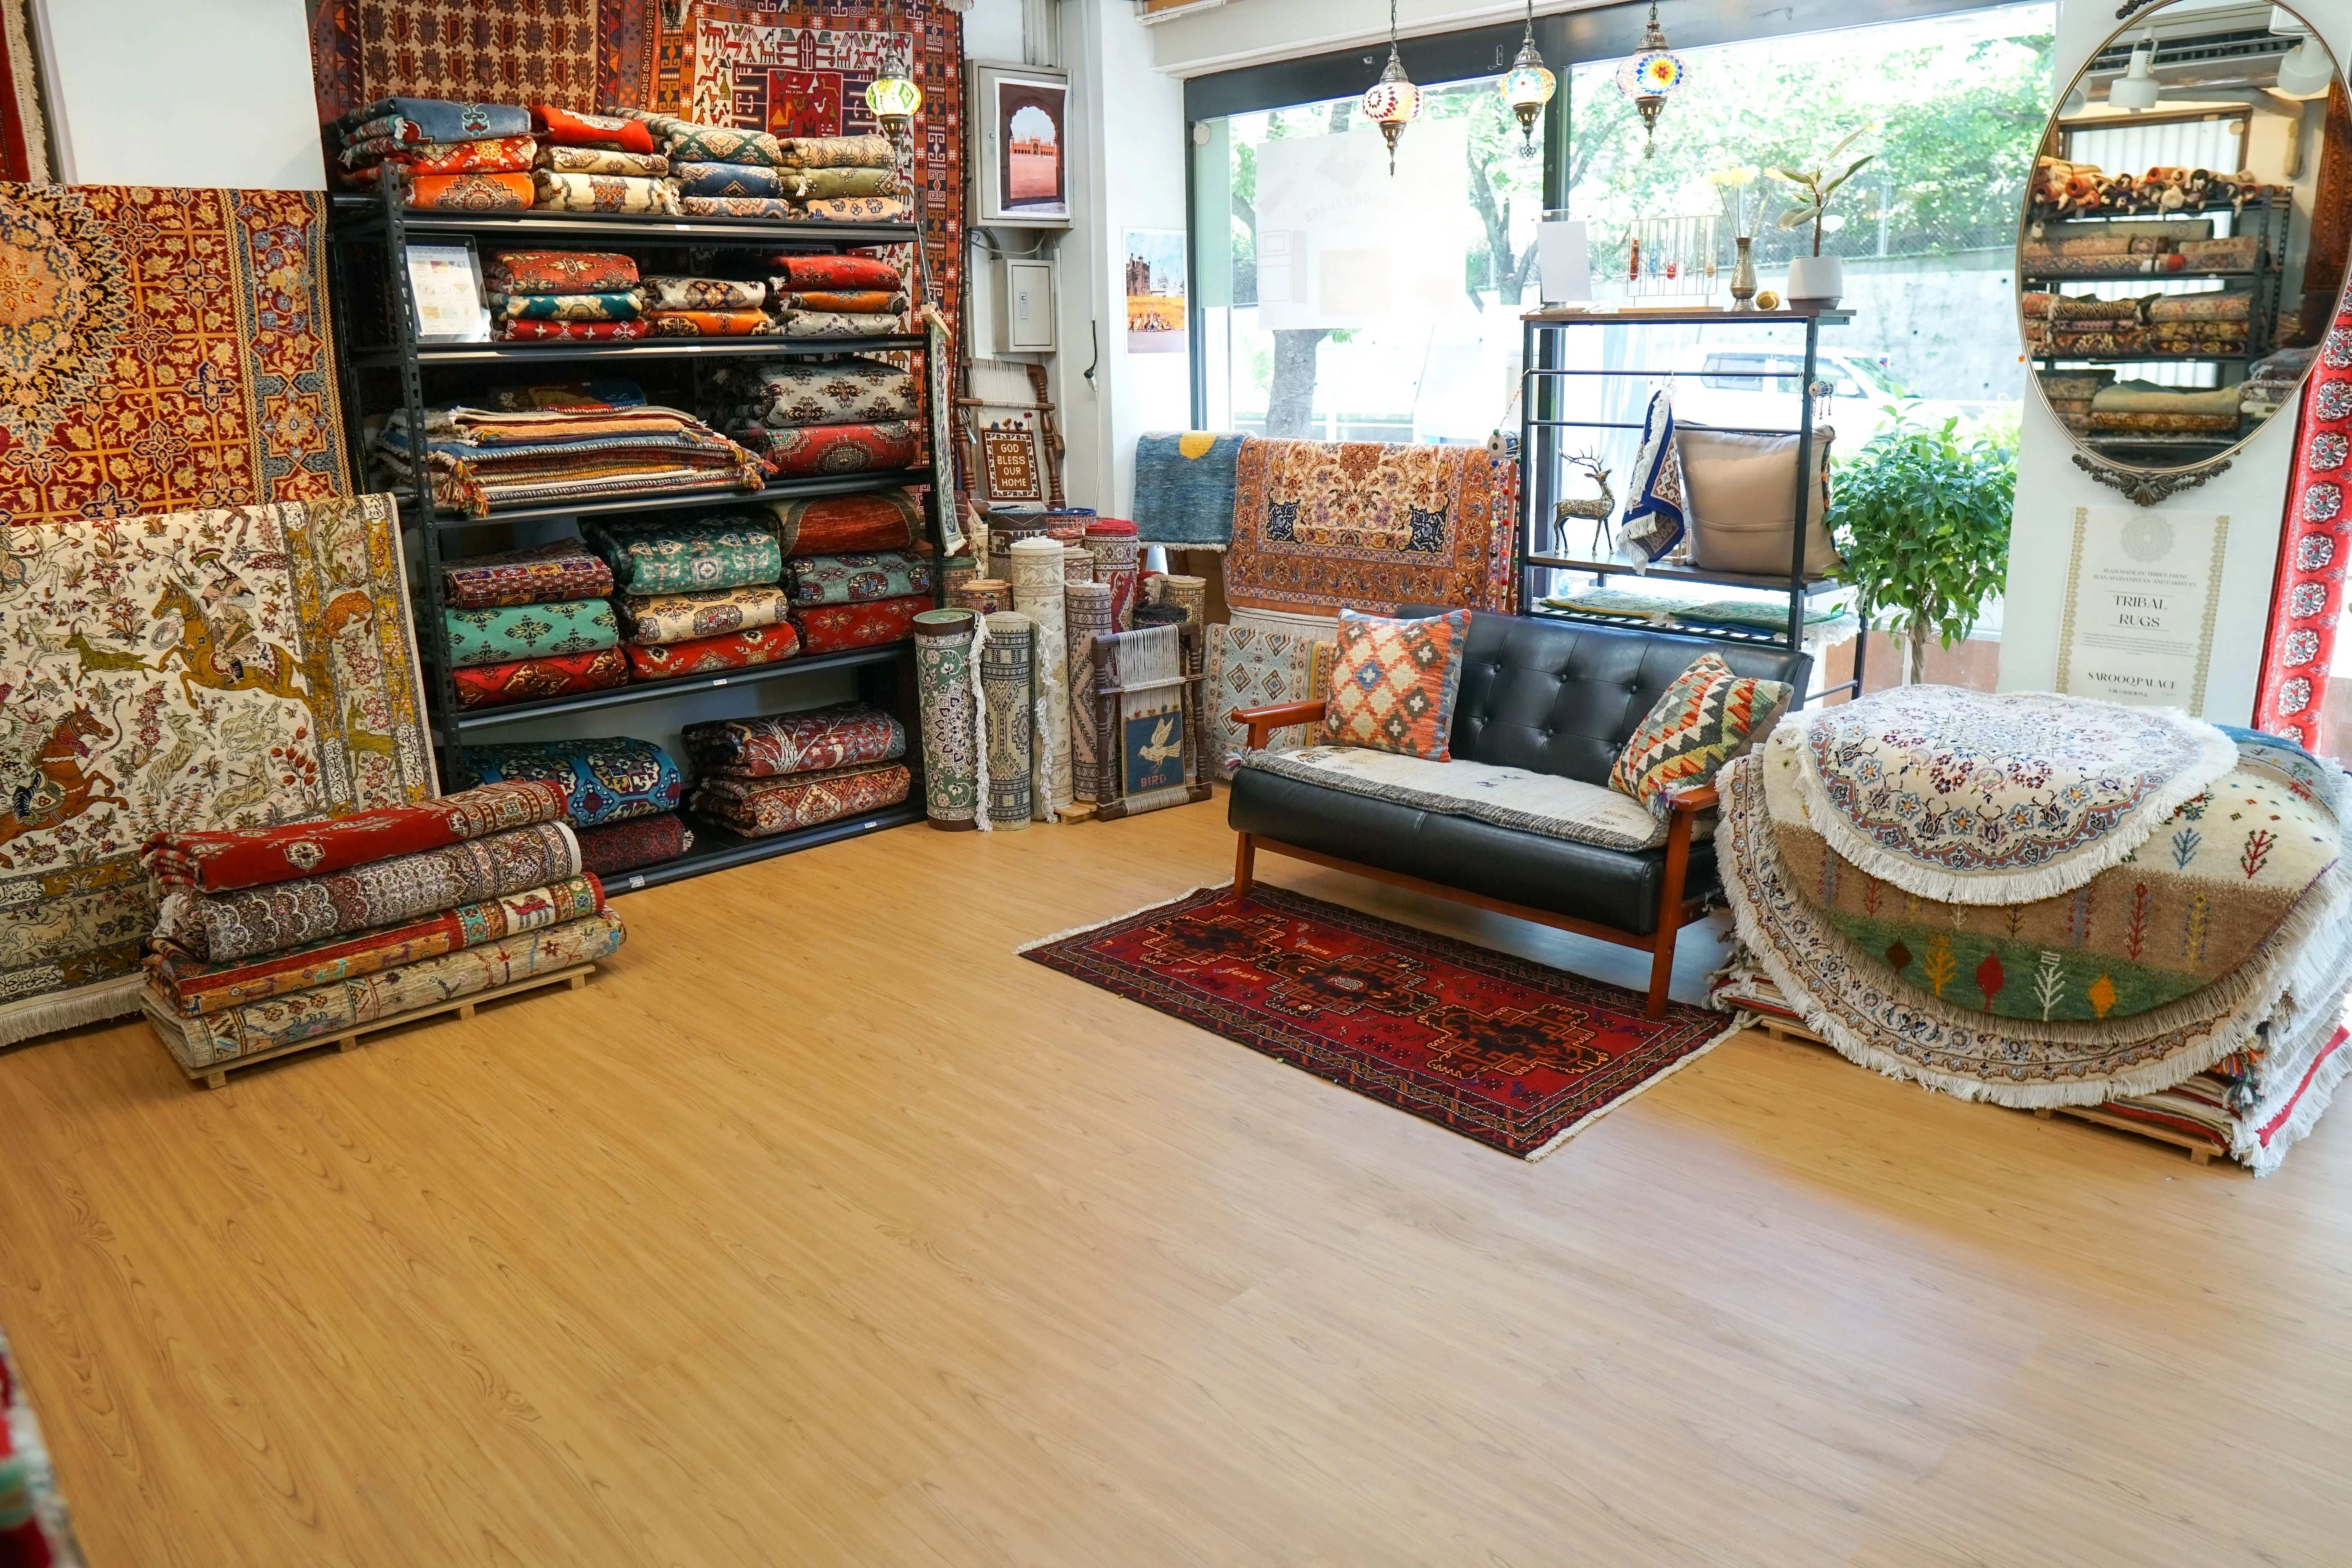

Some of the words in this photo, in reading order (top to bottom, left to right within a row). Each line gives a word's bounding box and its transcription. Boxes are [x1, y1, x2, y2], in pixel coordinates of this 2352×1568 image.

[1001, 444, 1019, 453] GOD
[997, 456, 1025, 465] BLESS
[1004, 467, 1022, 475] OUR
[1002, 478, 1026, 486] HOME
[2113, 595, 2167, 610] TRIBAL
[2120, 614, 2160, 628] RUGS
[2087, 671, 2177, 689] SAROOQPALACE
[1141, 774, 1167, 788] BIRD
